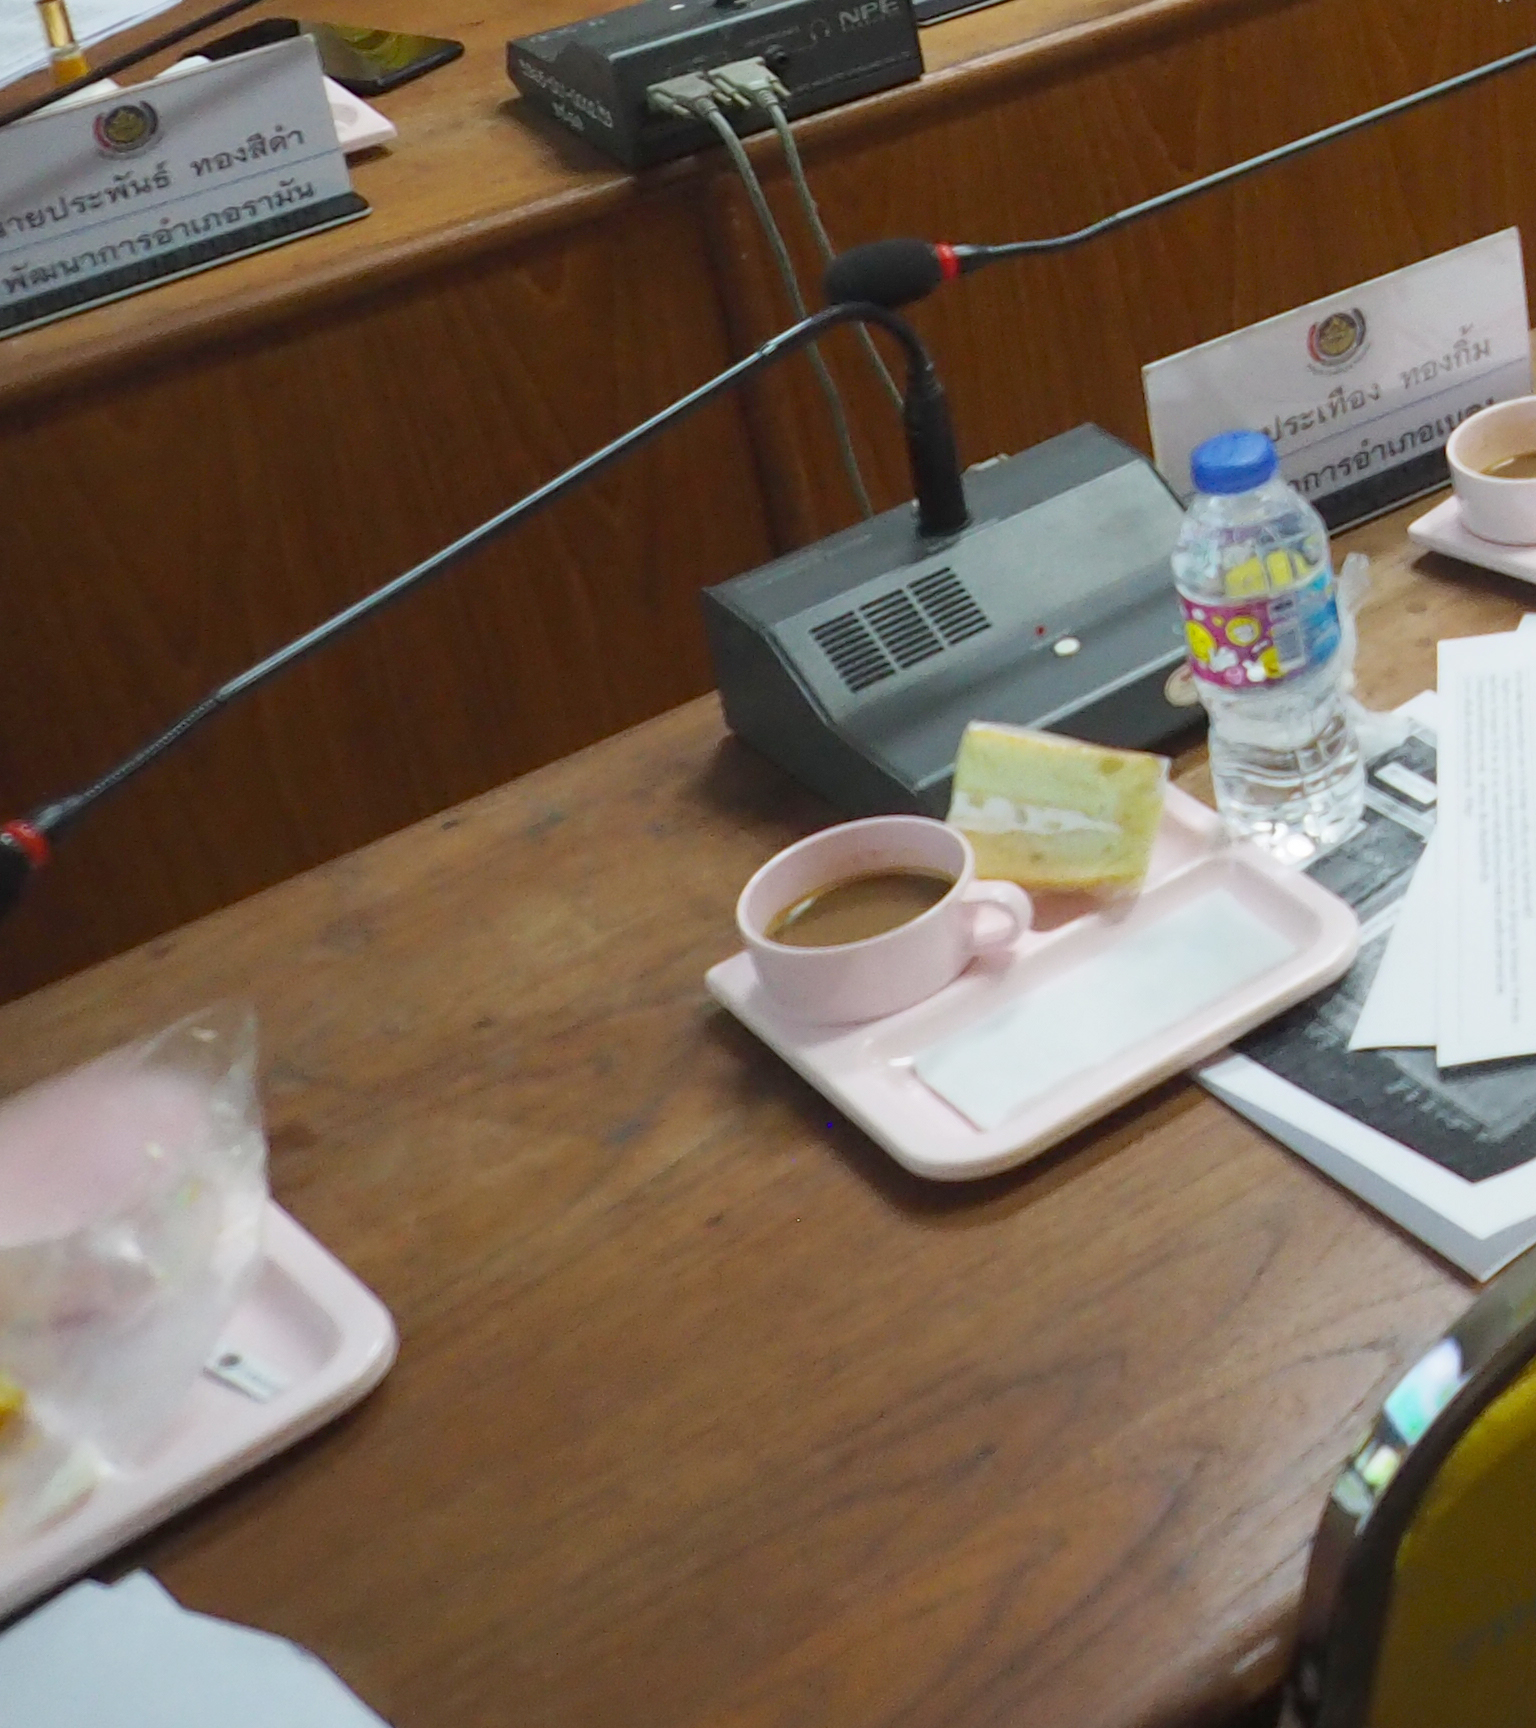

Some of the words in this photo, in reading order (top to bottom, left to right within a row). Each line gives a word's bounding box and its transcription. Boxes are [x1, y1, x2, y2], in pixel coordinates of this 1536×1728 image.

[2, 177, 315, 296] พัฒนาการอำเภอรามัน
